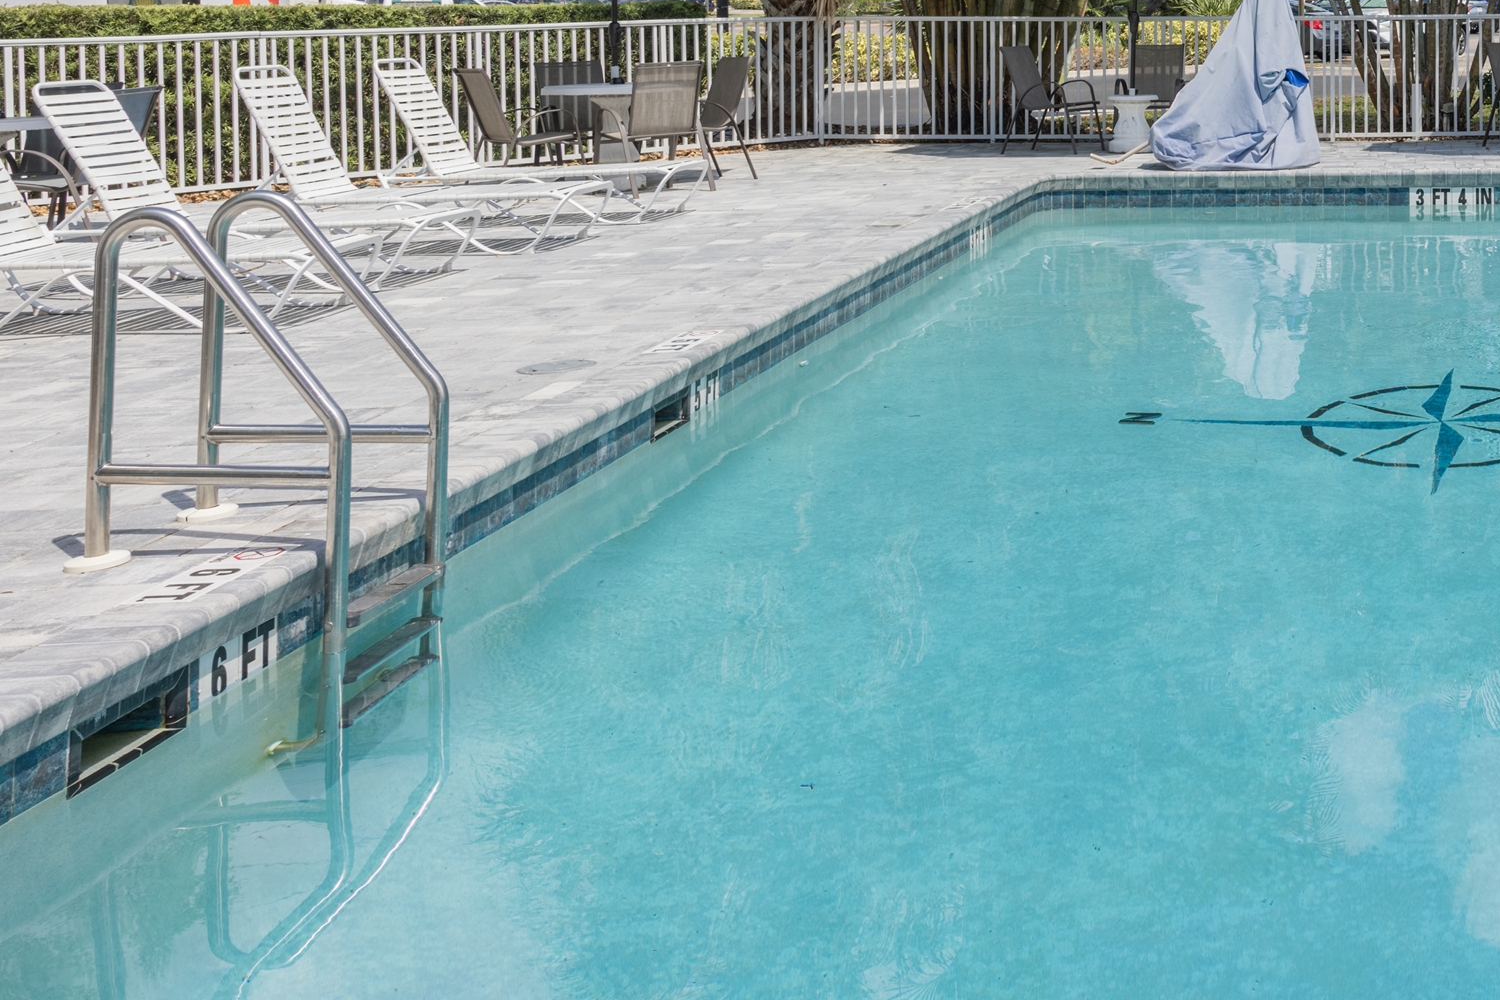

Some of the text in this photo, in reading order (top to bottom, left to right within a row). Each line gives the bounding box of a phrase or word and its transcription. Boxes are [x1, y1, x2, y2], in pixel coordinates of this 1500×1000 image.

[1415, 187, 1492, 206] 3 FT 4 IN
[694, 370, 719, 412] 5 FT
[189, 567, 241, 577] 6
[211, 617, 275, 697] 6 FT
